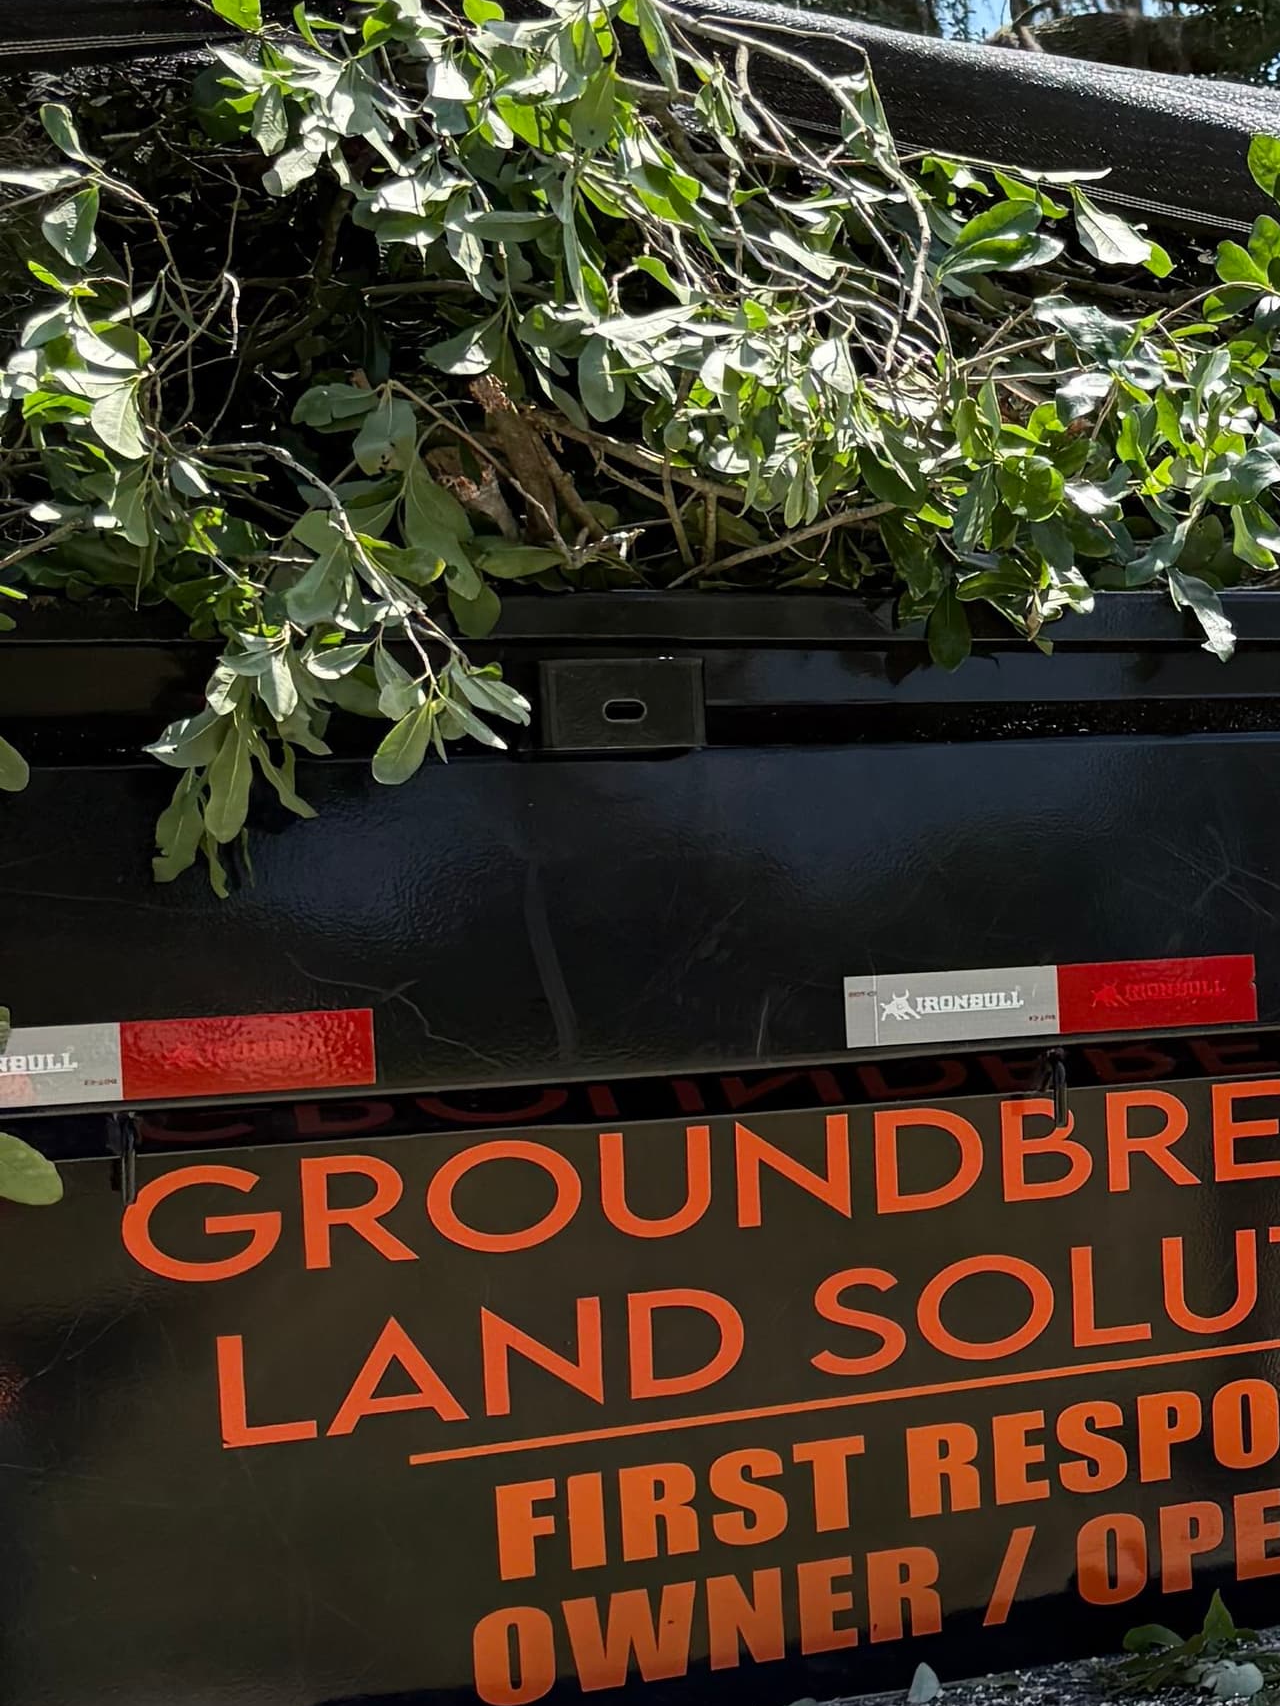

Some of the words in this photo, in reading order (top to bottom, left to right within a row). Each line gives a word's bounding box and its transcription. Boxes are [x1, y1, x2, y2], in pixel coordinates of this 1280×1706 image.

[915, 990, 1024, 1014] IRONBULL
[216, 1288, 745, 1449] LAND
[495, 1435, 868, 1581] FIRST
[472, 1546, 941, 1706] OWNER
[984, 1526, 1034, 1626] /
